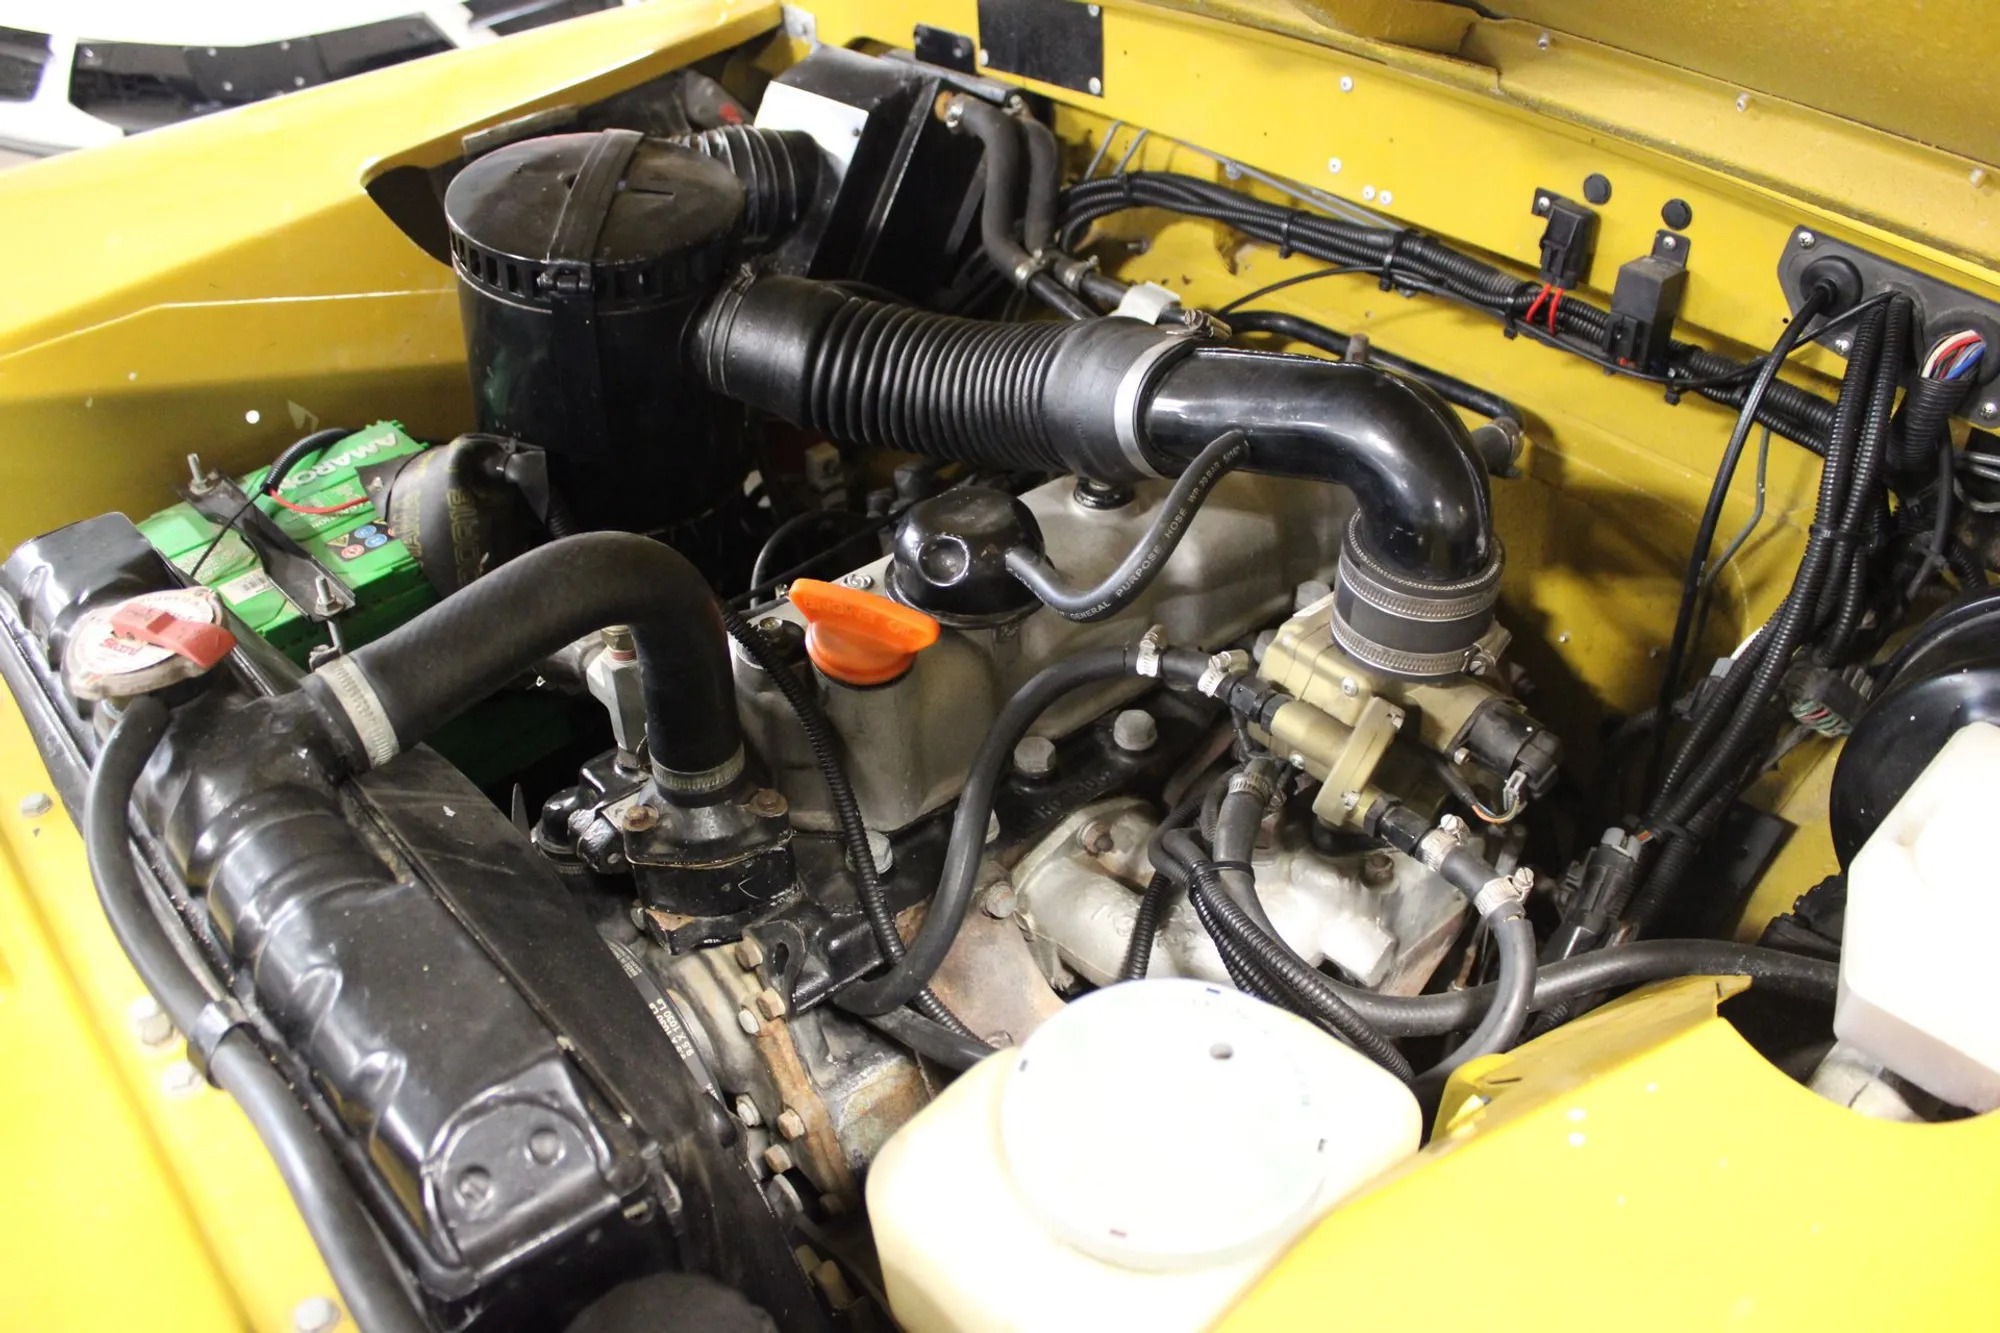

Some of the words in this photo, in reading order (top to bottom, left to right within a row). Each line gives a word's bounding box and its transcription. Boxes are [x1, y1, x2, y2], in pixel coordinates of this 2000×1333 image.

[1069, 600, 1112, 621] GENERAL
[1115, 543, 1162, 598] PURPOSE
[1164, 507, 1188, 539] HOSE
[663, 1011, 681, 1032] 1030
[676, 1031, 687, 1041] X
[681, 1041, 695, 1057] 9.5
